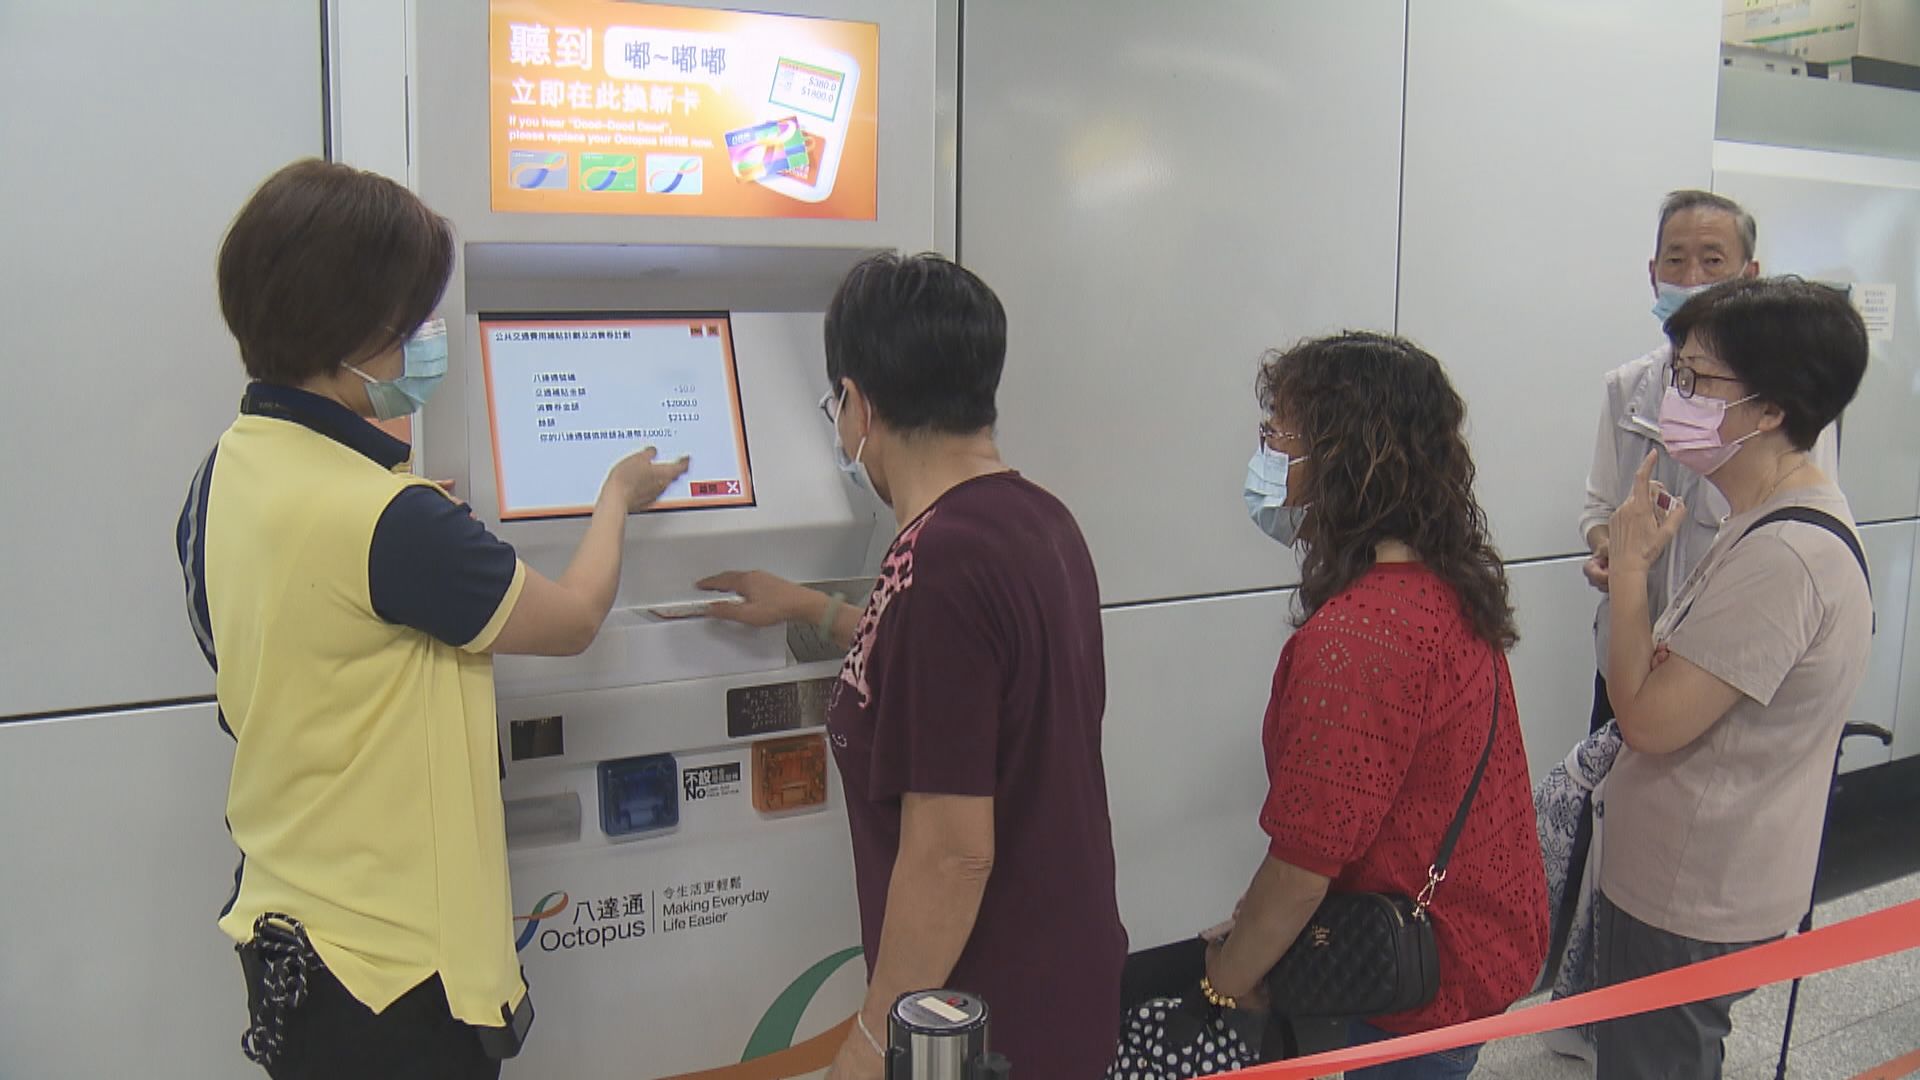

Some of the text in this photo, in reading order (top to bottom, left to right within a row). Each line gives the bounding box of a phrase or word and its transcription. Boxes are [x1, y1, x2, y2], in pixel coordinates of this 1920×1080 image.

[508, 22, 593, 70] 聽到
[510, 77, 701, 117] 立即在此換新卡
[509, 114, 518, 125] If
[519, 117, 540, 129] you
[542, 116, 565, 128] hear
[509, 130, 545, 143] please
[546, 133, 585, 146] replace
[588, 135, 612, 147] your
[614, 134, 657, 148] Octopus
[685, 784, 706, 801] No
[663, 875, 743, 899] 令生活更輕鬆
[572, 893, 645, 926] 八達通
[662, 888, 769, 918] Making Everyday
[662, 911, 728, 933] Life Easier
[540, 920, 646, 952] Octopus
